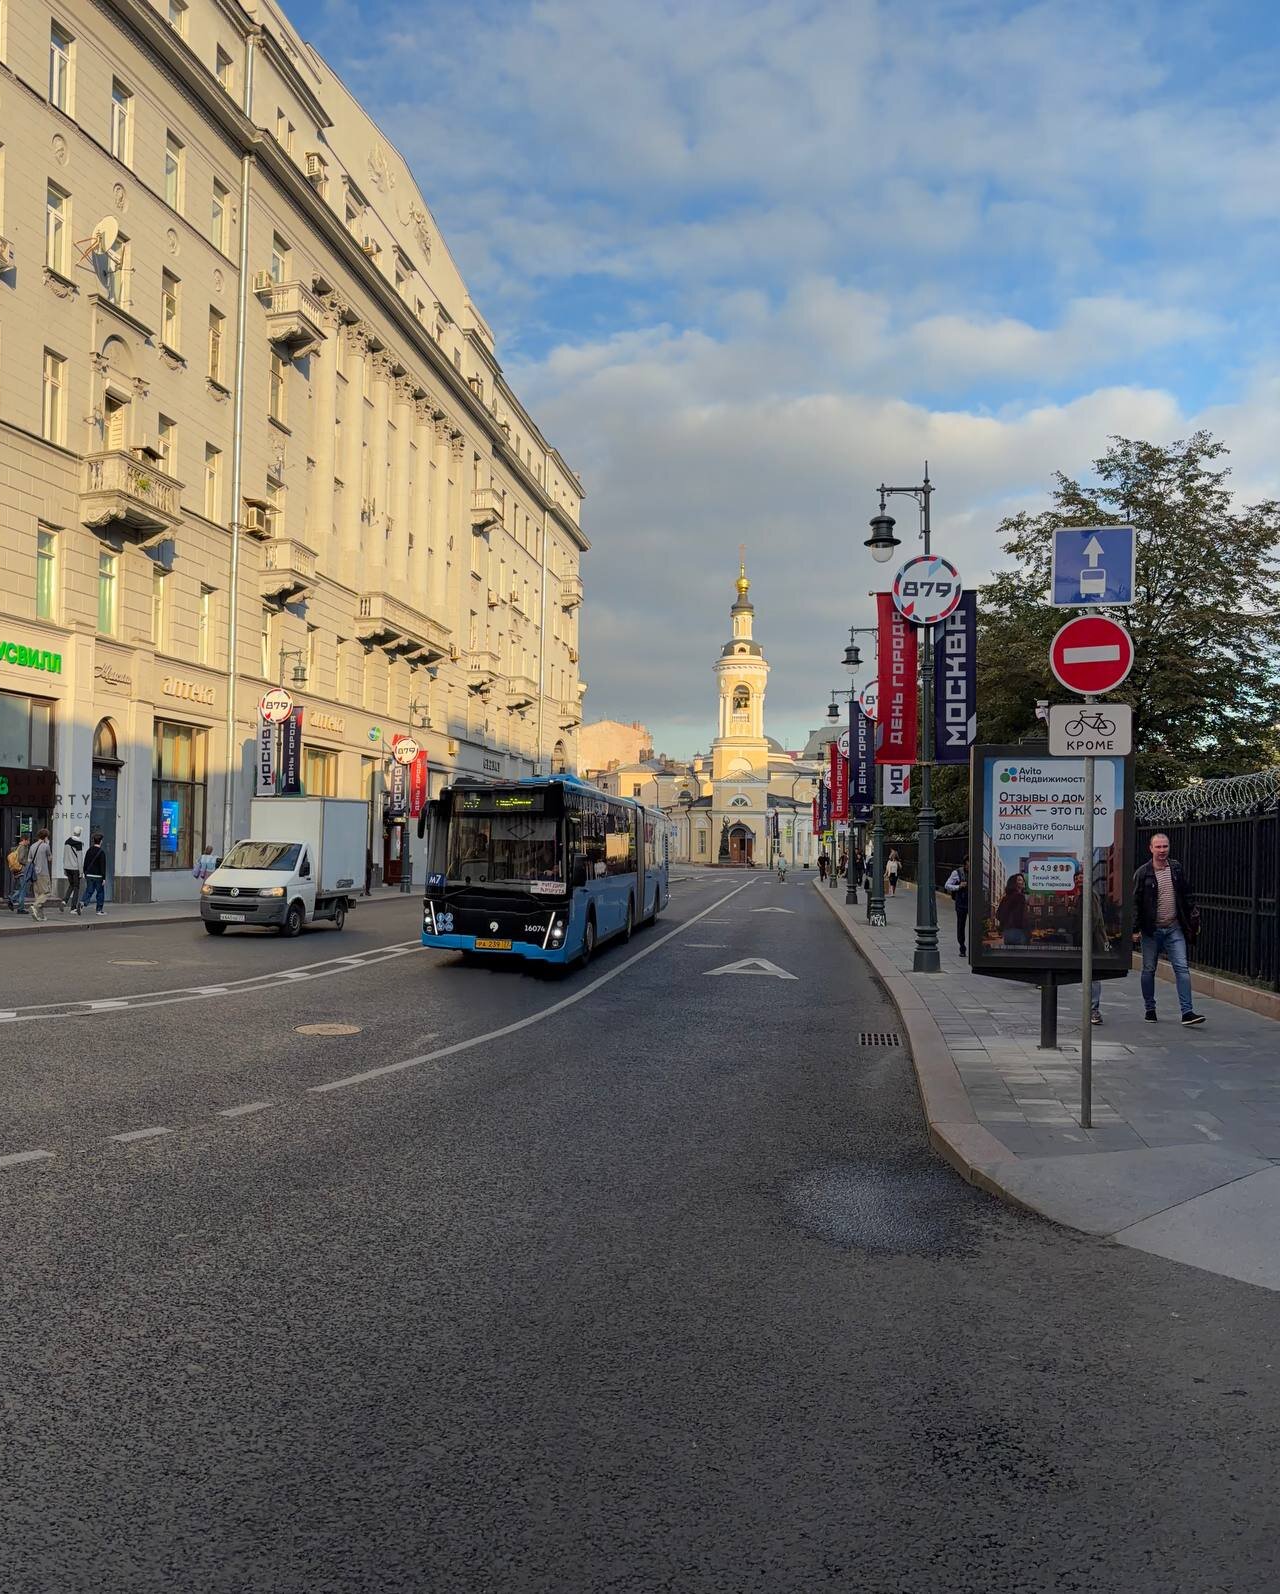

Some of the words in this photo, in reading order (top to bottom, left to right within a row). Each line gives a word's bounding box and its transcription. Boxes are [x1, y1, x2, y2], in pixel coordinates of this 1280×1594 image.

[903, 581, 952, 598] 879
[892, 611, 905, 687] ГОРОДА
[945, 610, 967, 746] МОСКВА
[266, 702, 288, 710] 879
[890, 692, 903, 745] ДЕНЬ
[398, 747, 416, 755] 879
[1066, 741, 1114, 750] КРОМЕ
[1019, 767, 1042, 775] Avito
[858, 763, 867, 794] ДЕНЬ
[999, 792, 1049, 803] Отзывы
[1051, 794, 1059, 803] о
[1061, 794, 1102, 804] домх
[999, 807, 1007, 815] и
[1010, 805, 1032, 816] ЖК
[1050, 807, 1072, 815] это
[999, 822, 1049, 831] Узнавайте
[999, 833, 1012, 841] до
[1013, 833, 1054, 842] покупки
